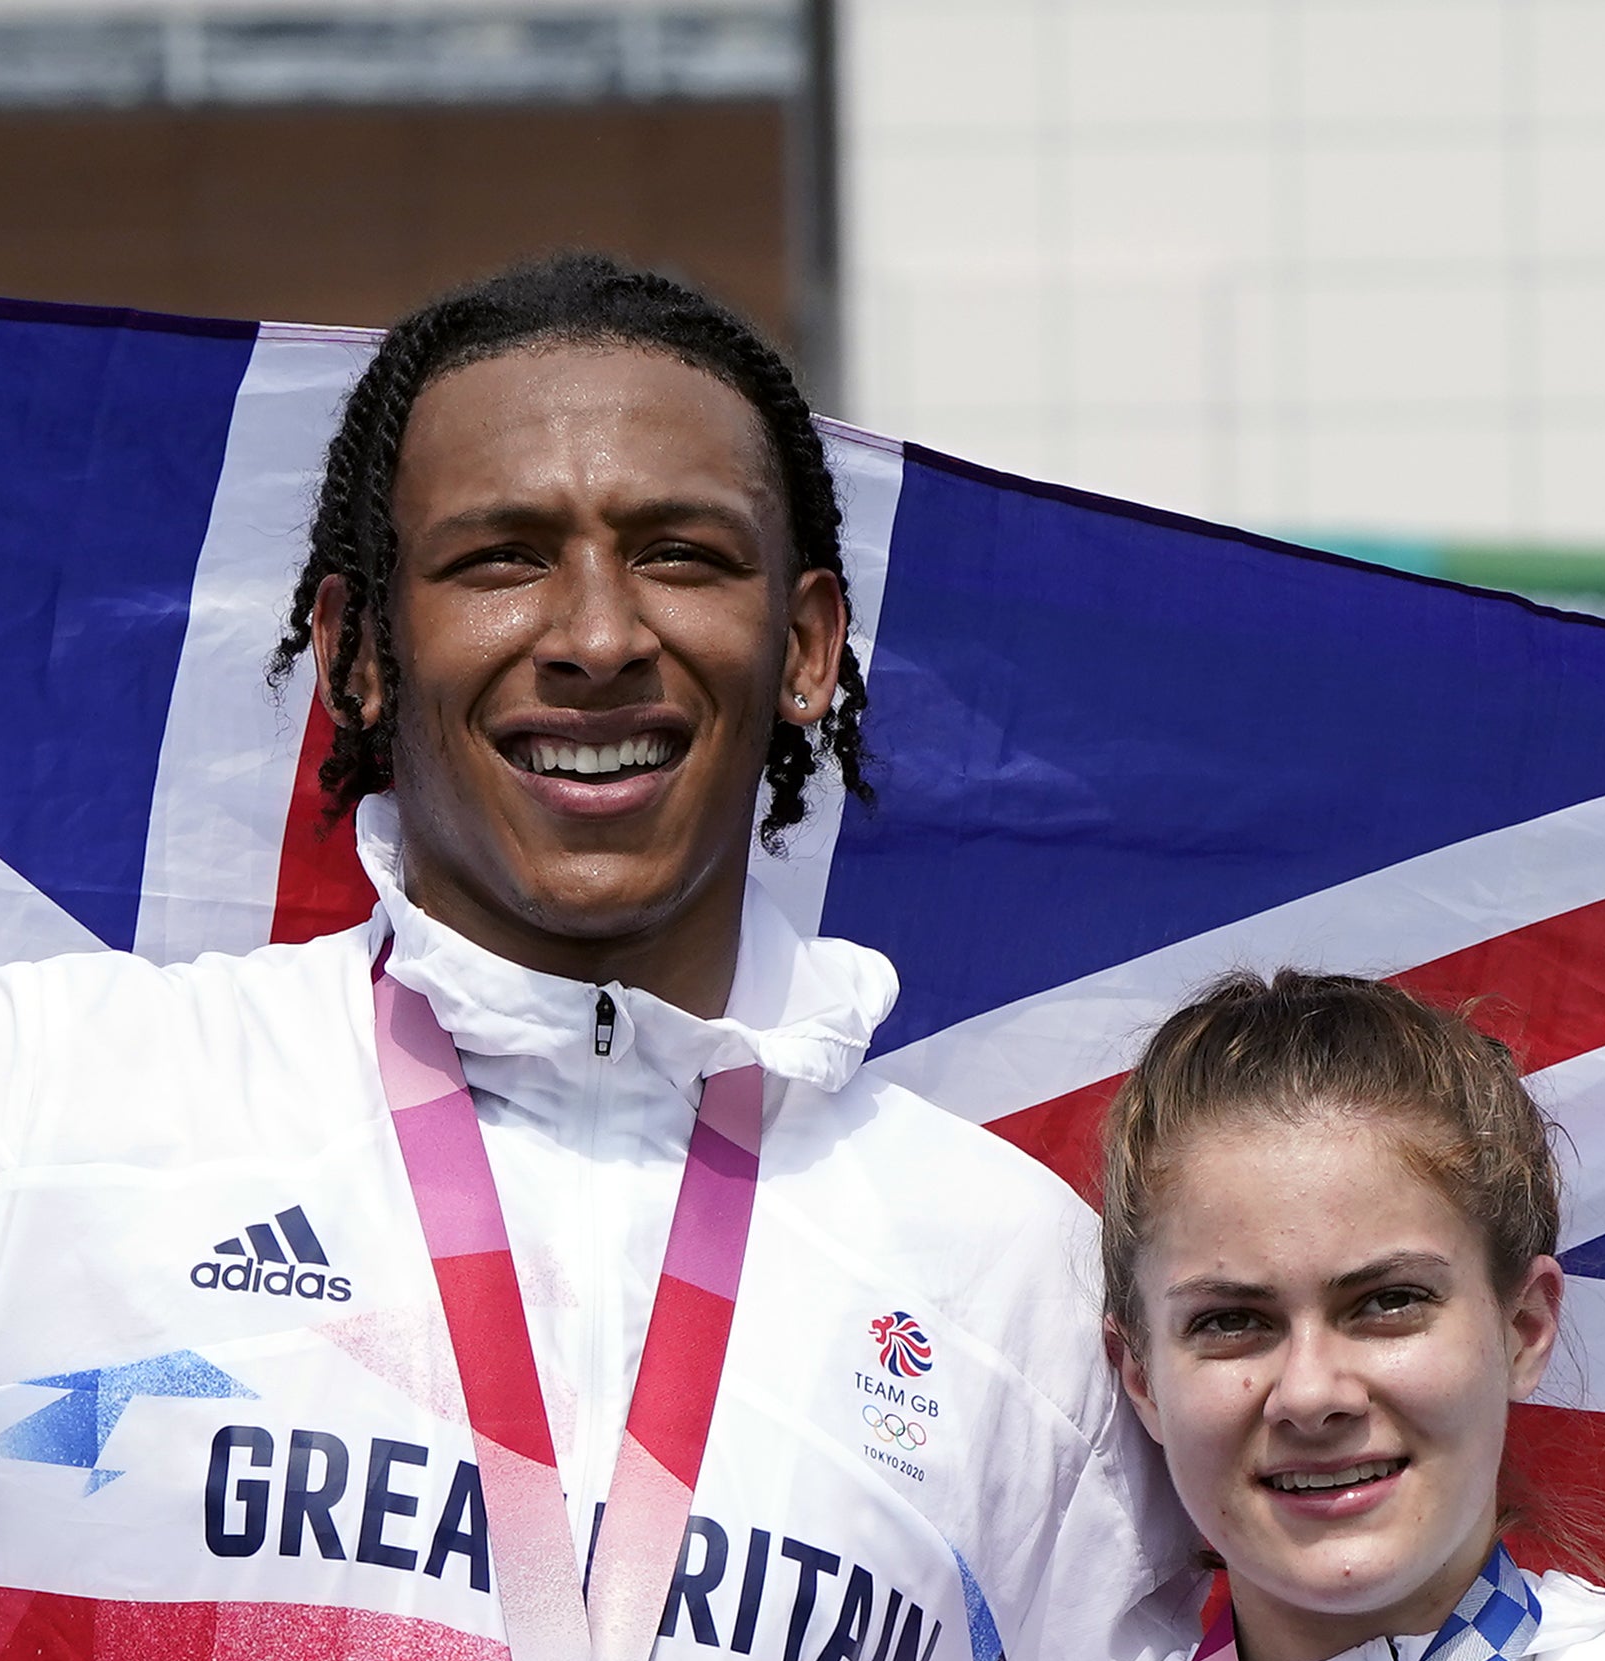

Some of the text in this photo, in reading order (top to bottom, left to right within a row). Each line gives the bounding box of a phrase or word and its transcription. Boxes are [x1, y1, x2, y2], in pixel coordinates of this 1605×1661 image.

[190, 1257, 352, 1302] adidas
[854, 1371, 939, 1418] TEAM GB
[863, 1443, 926, 1482] TOKYO 2020
[204, 1424, 514, 1594] GREA
